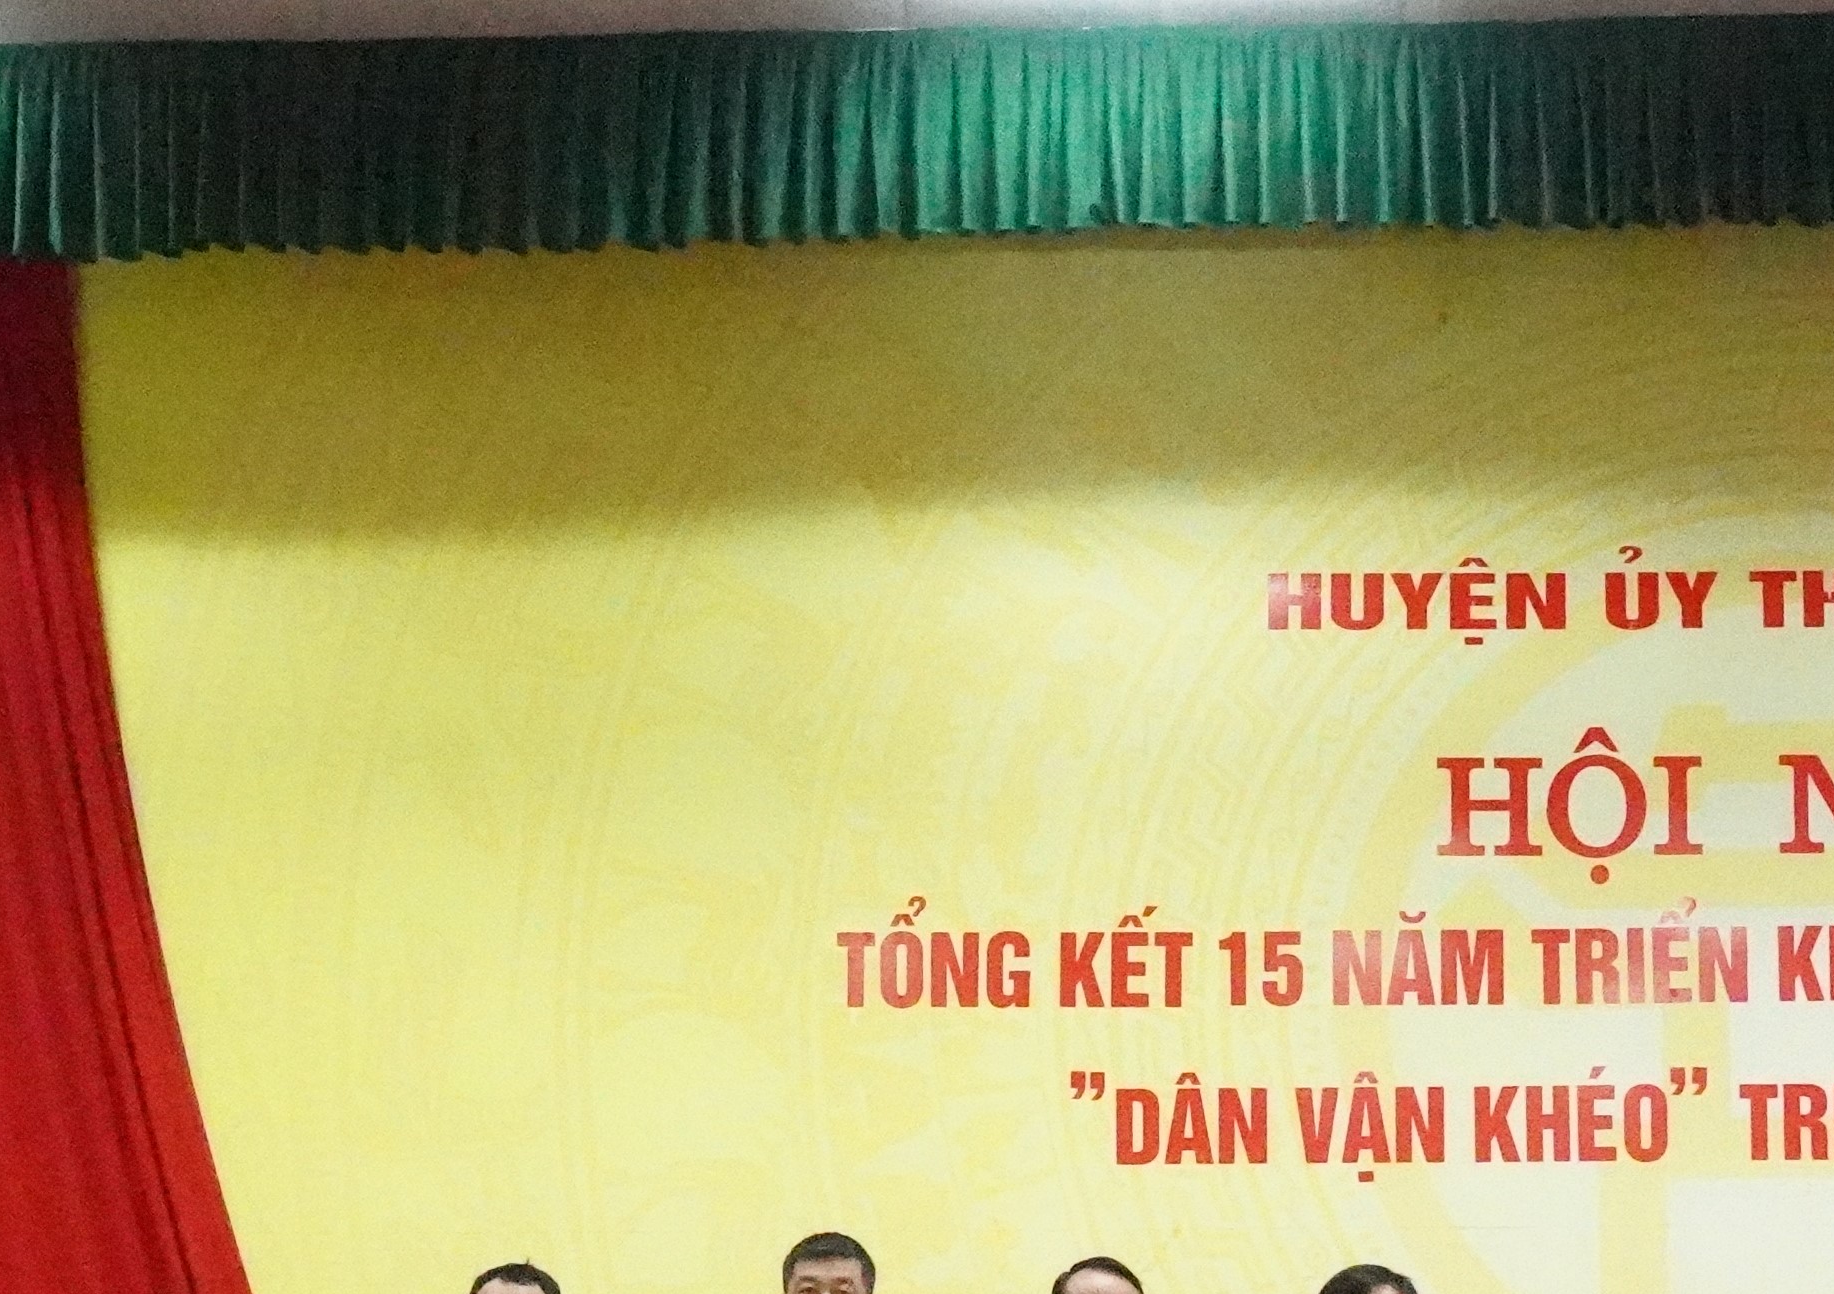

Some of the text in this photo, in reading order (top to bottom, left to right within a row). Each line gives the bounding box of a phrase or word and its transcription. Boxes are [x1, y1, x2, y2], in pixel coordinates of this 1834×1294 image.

[1267, 556, 1569, 646] HUYỆN
[1603, 544, 1719, 631] ỦY
[1436, 726, 1704, 885] HỘI
[837, 896, 1032, 1010] TỔNG
[1058, 905, 1195, 1009] KẾT
[1218, 930, 1304, 1008] 15
[1332, 911, 1506, 1006] NĂM
[1529, 897, 1750, 1006] TRIỂN
[1294, 1071, 1447, 1184] VẬN
